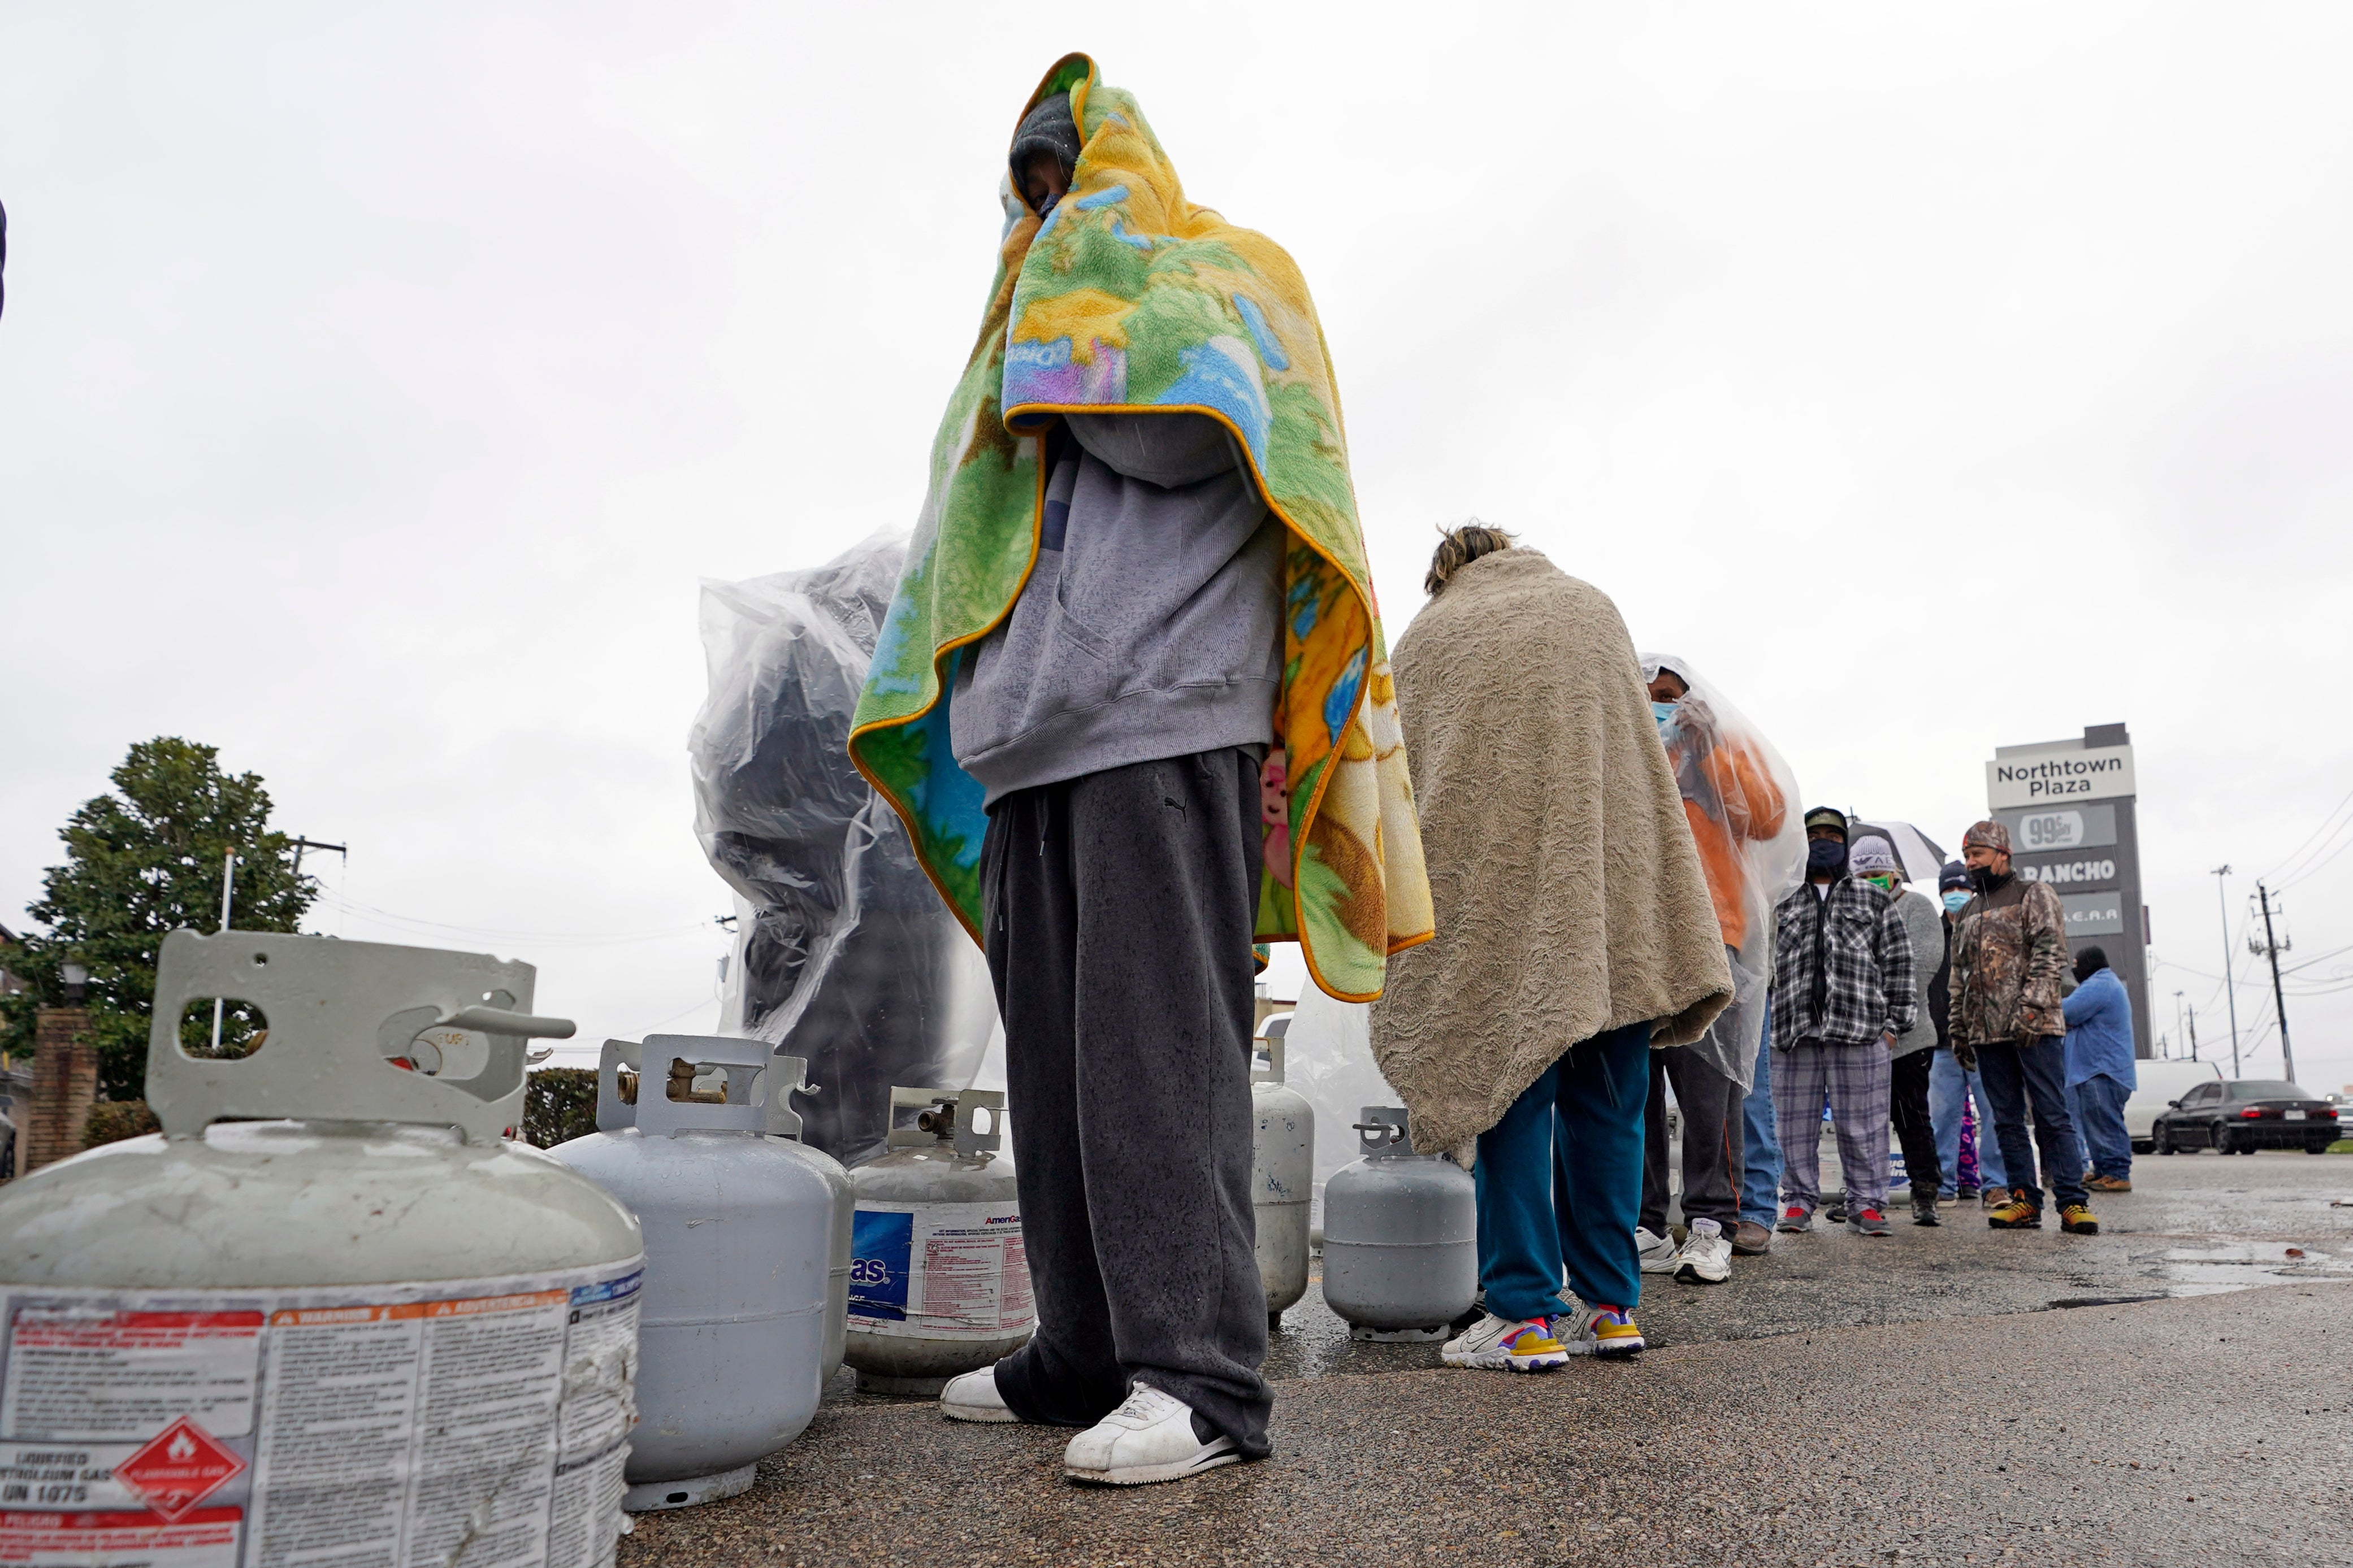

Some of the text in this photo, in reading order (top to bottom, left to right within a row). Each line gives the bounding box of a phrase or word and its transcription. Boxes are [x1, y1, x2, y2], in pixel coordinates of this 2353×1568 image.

[1997, 757, 2122, 783] Northtown
[2030, 779, 2091, 797] Plaza
[2023, 859, 2116, 884] RANCHO
[3, 1485, 88, 1502] UN 1075
